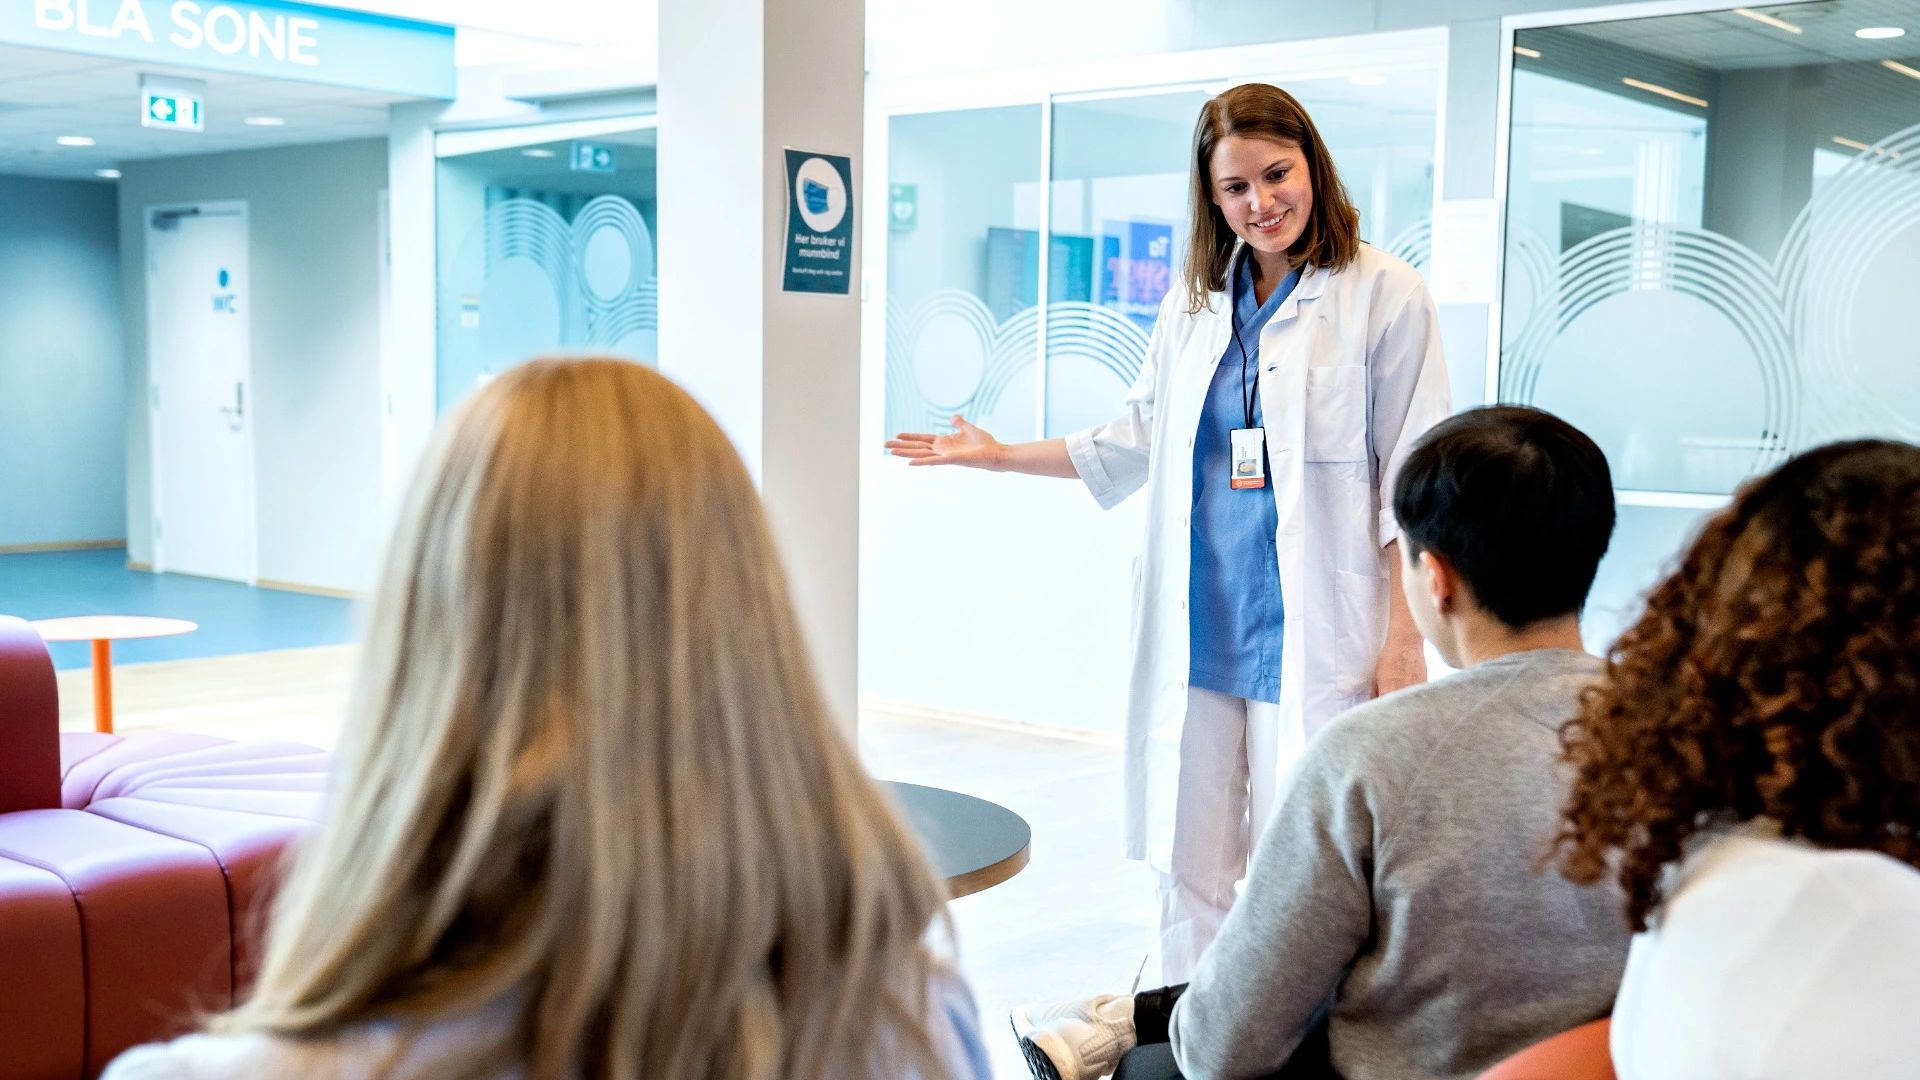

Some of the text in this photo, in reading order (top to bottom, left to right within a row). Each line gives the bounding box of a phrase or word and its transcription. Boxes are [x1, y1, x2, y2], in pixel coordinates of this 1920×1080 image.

[169, 0, 320, 65] SONE
[795, 233, 845, 247] Her bruker vi
[799, 249, 839, 259] munnbind
[212, 294, 237, 314] WC
